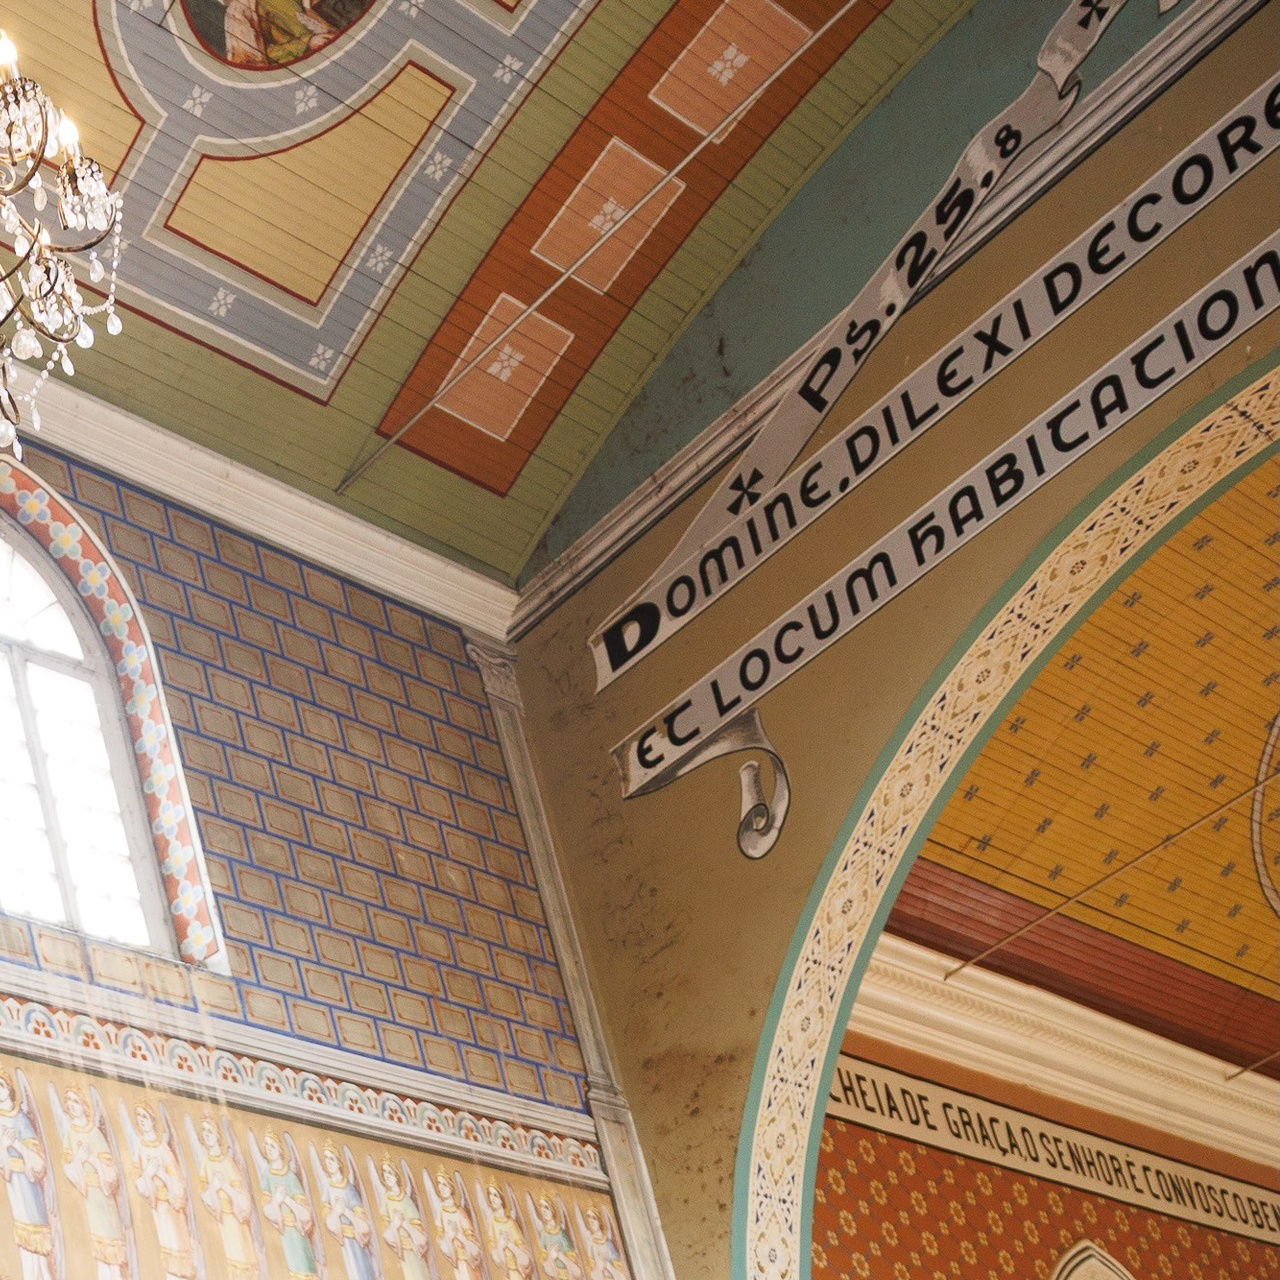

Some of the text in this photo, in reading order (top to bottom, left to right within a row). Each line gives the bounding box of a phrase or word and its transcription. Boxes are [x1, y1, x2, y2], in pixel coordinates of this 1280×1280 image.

[829, 1067, 904, 1122] HEIA
[900, 1087, 938, 1131] DE
[1039, 1132, 1129, 1189] SENHOR
